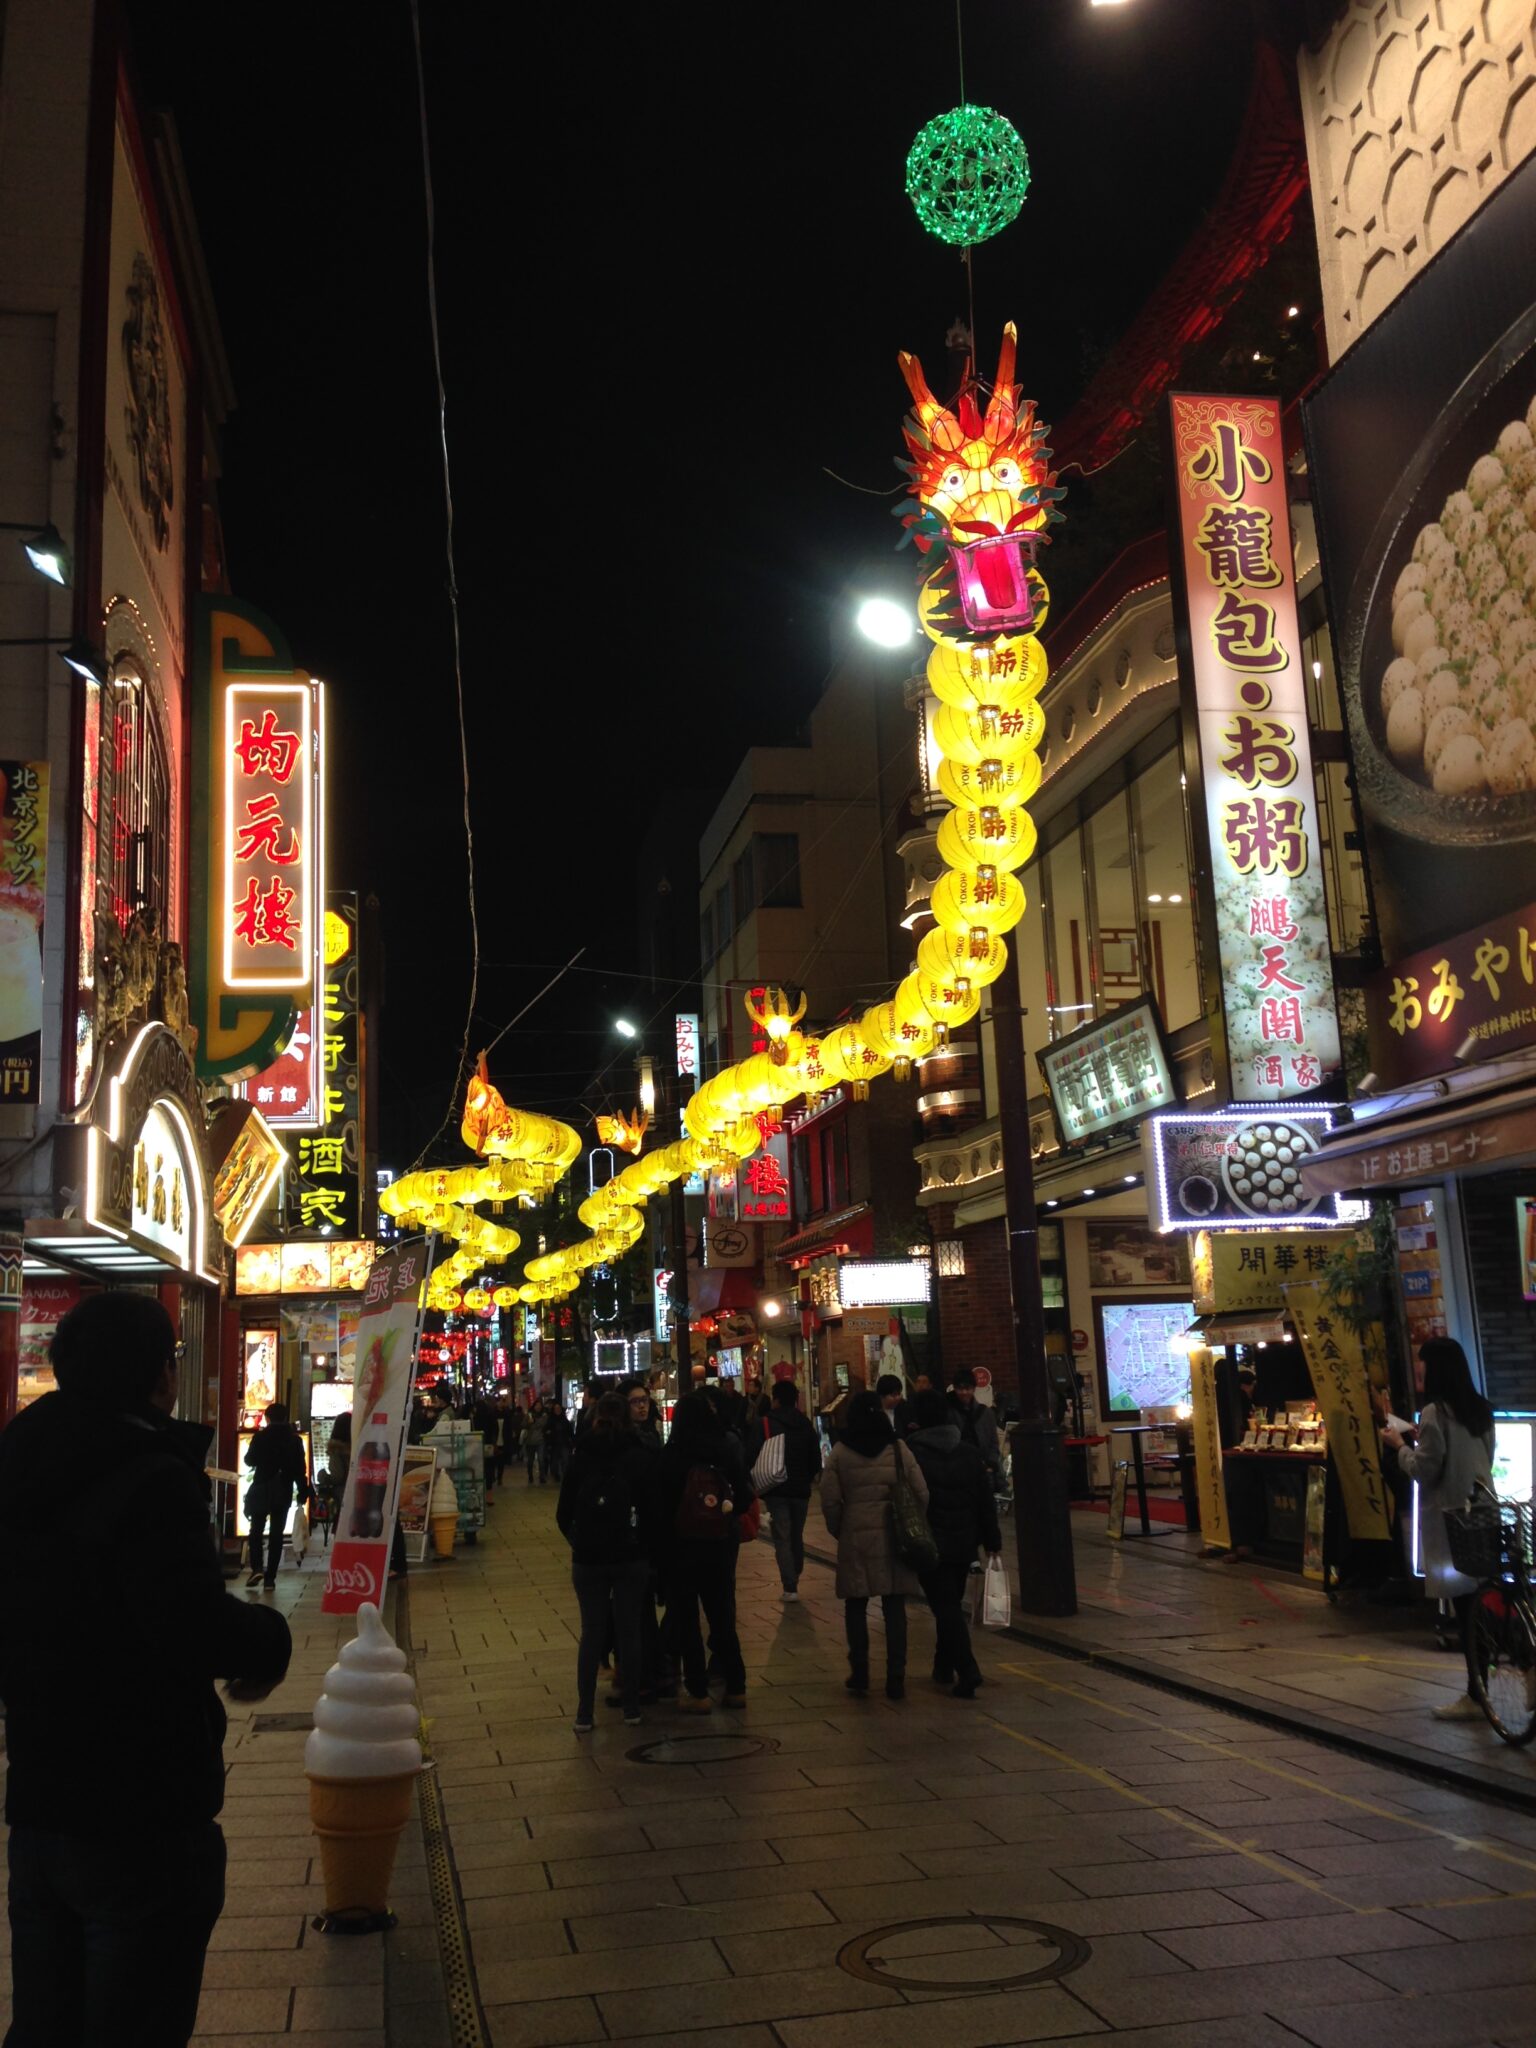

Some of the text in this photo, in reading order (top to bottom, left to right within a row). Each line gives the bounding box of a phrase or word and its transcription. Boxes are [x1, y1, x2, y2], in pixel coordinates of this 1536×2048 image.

[1188, 420, 1308, 878] 小籠包・お粥
[11, 767, 38, 886] 北京ダック
[0, 1069, 30, 1095] 円
[1255, 1054, 1322, 1089] 酒家
[257, 1085, 298, 1103] 新館
[1361, 1132, 1498, 1180] 1F お土産コーナー
